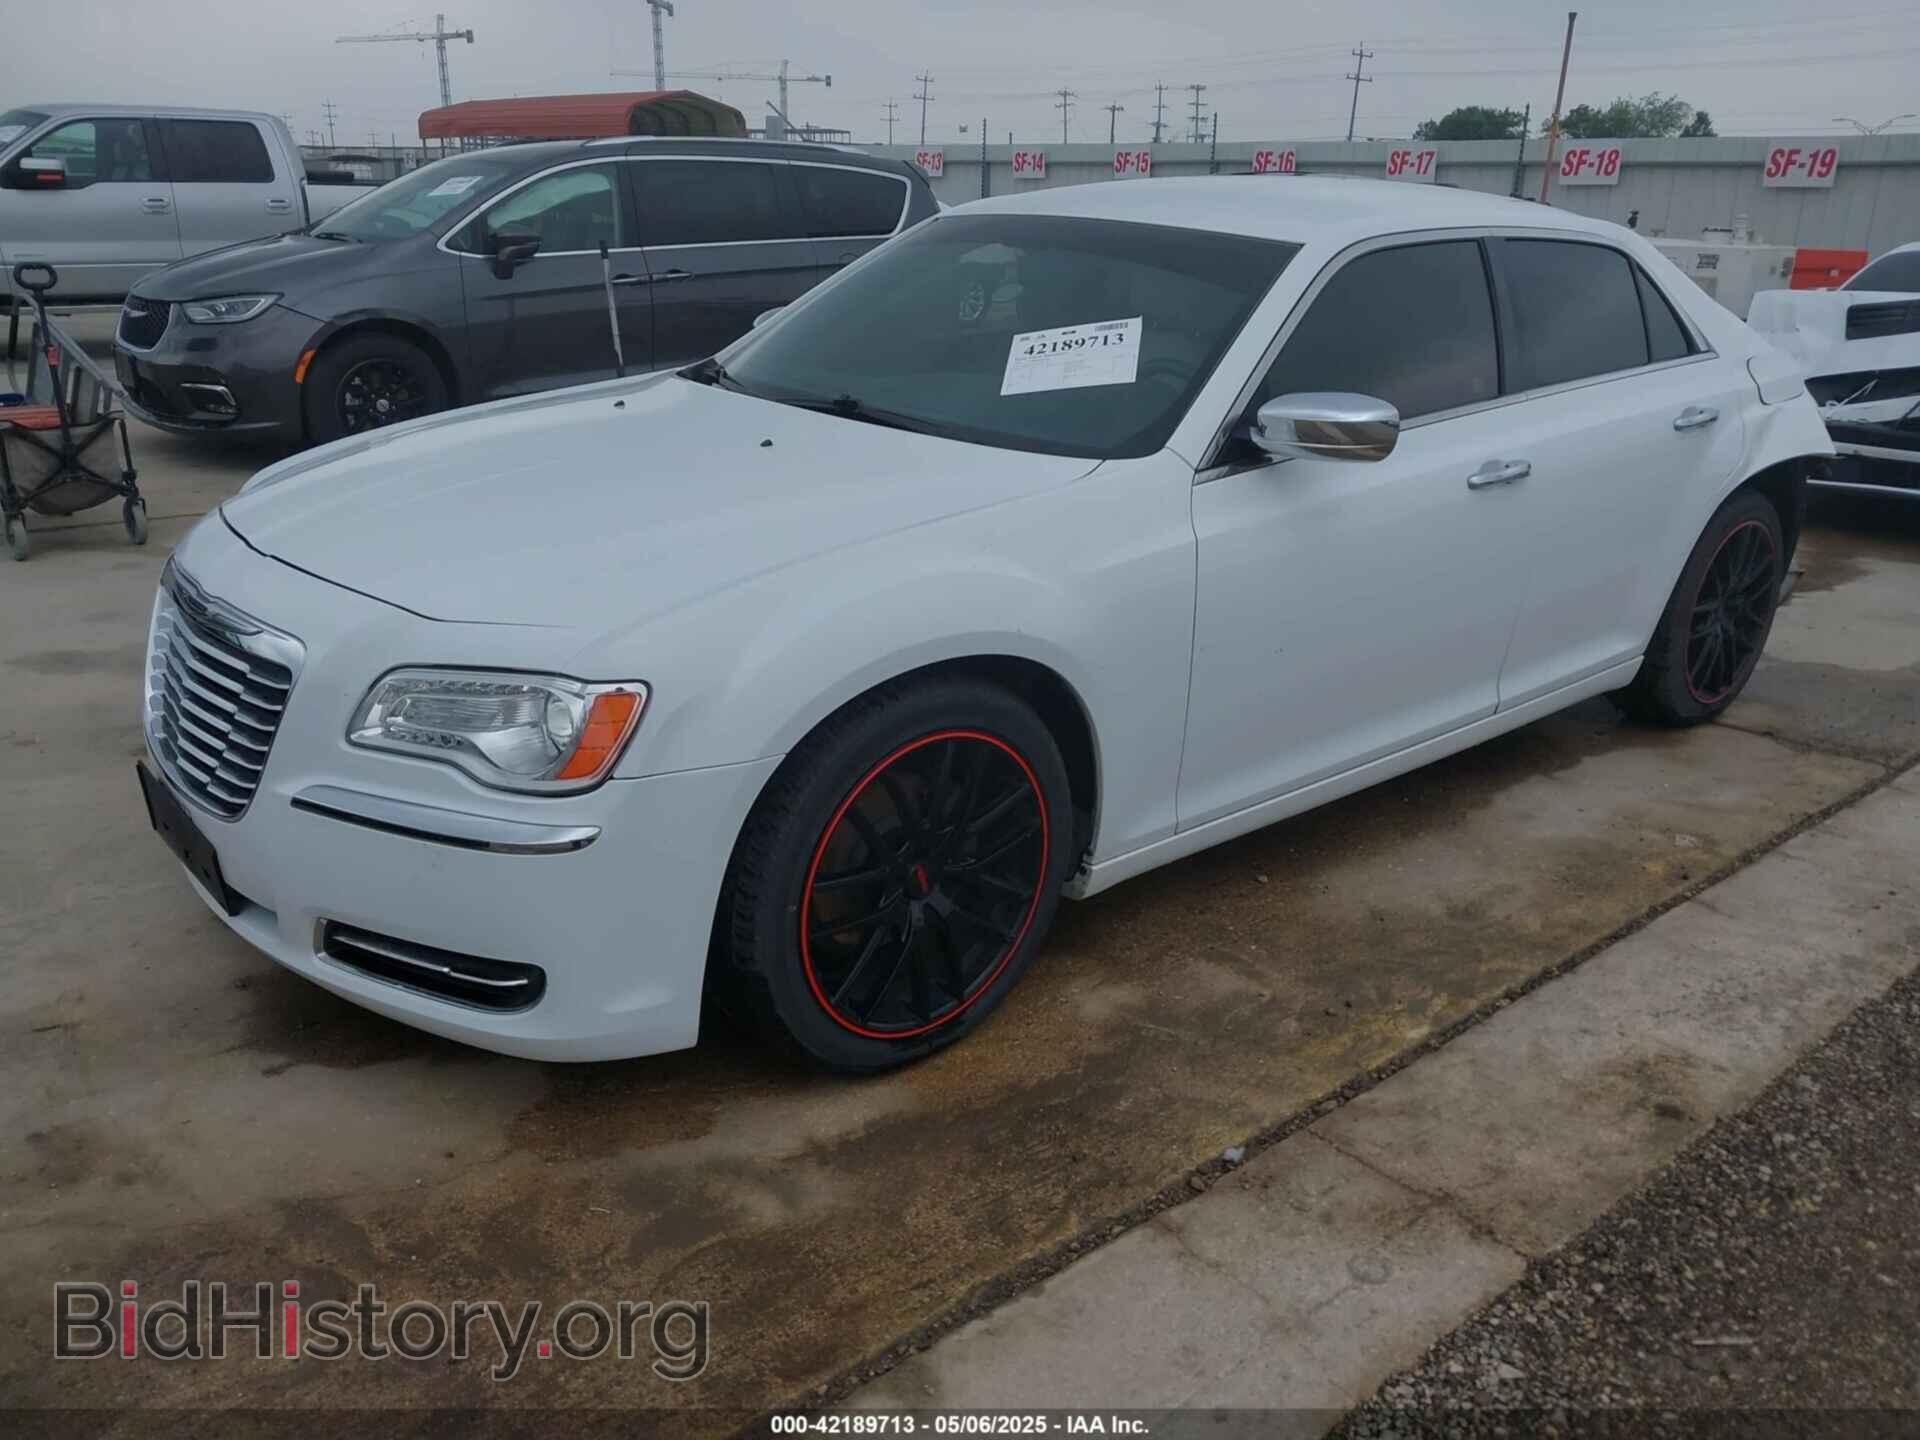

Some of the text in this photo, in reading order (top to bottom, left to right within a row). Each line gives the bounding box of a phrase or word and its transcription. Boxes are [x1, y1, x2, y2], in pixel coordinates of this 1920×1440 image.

[916, 151, 943, 171] SF-13
[1014, 151, 1044, 173] SF-14
[1114, 150, 1150, 174] SF-15
[1254, 150, 1296, 174] SF-16
[1387, 150, 1435, 176] SF-17
[1561, 149, 1620, 177] SF-18
[1766, 148, 1837, 178] SF-19
[1024, 333, 1124, 356] 42189713
